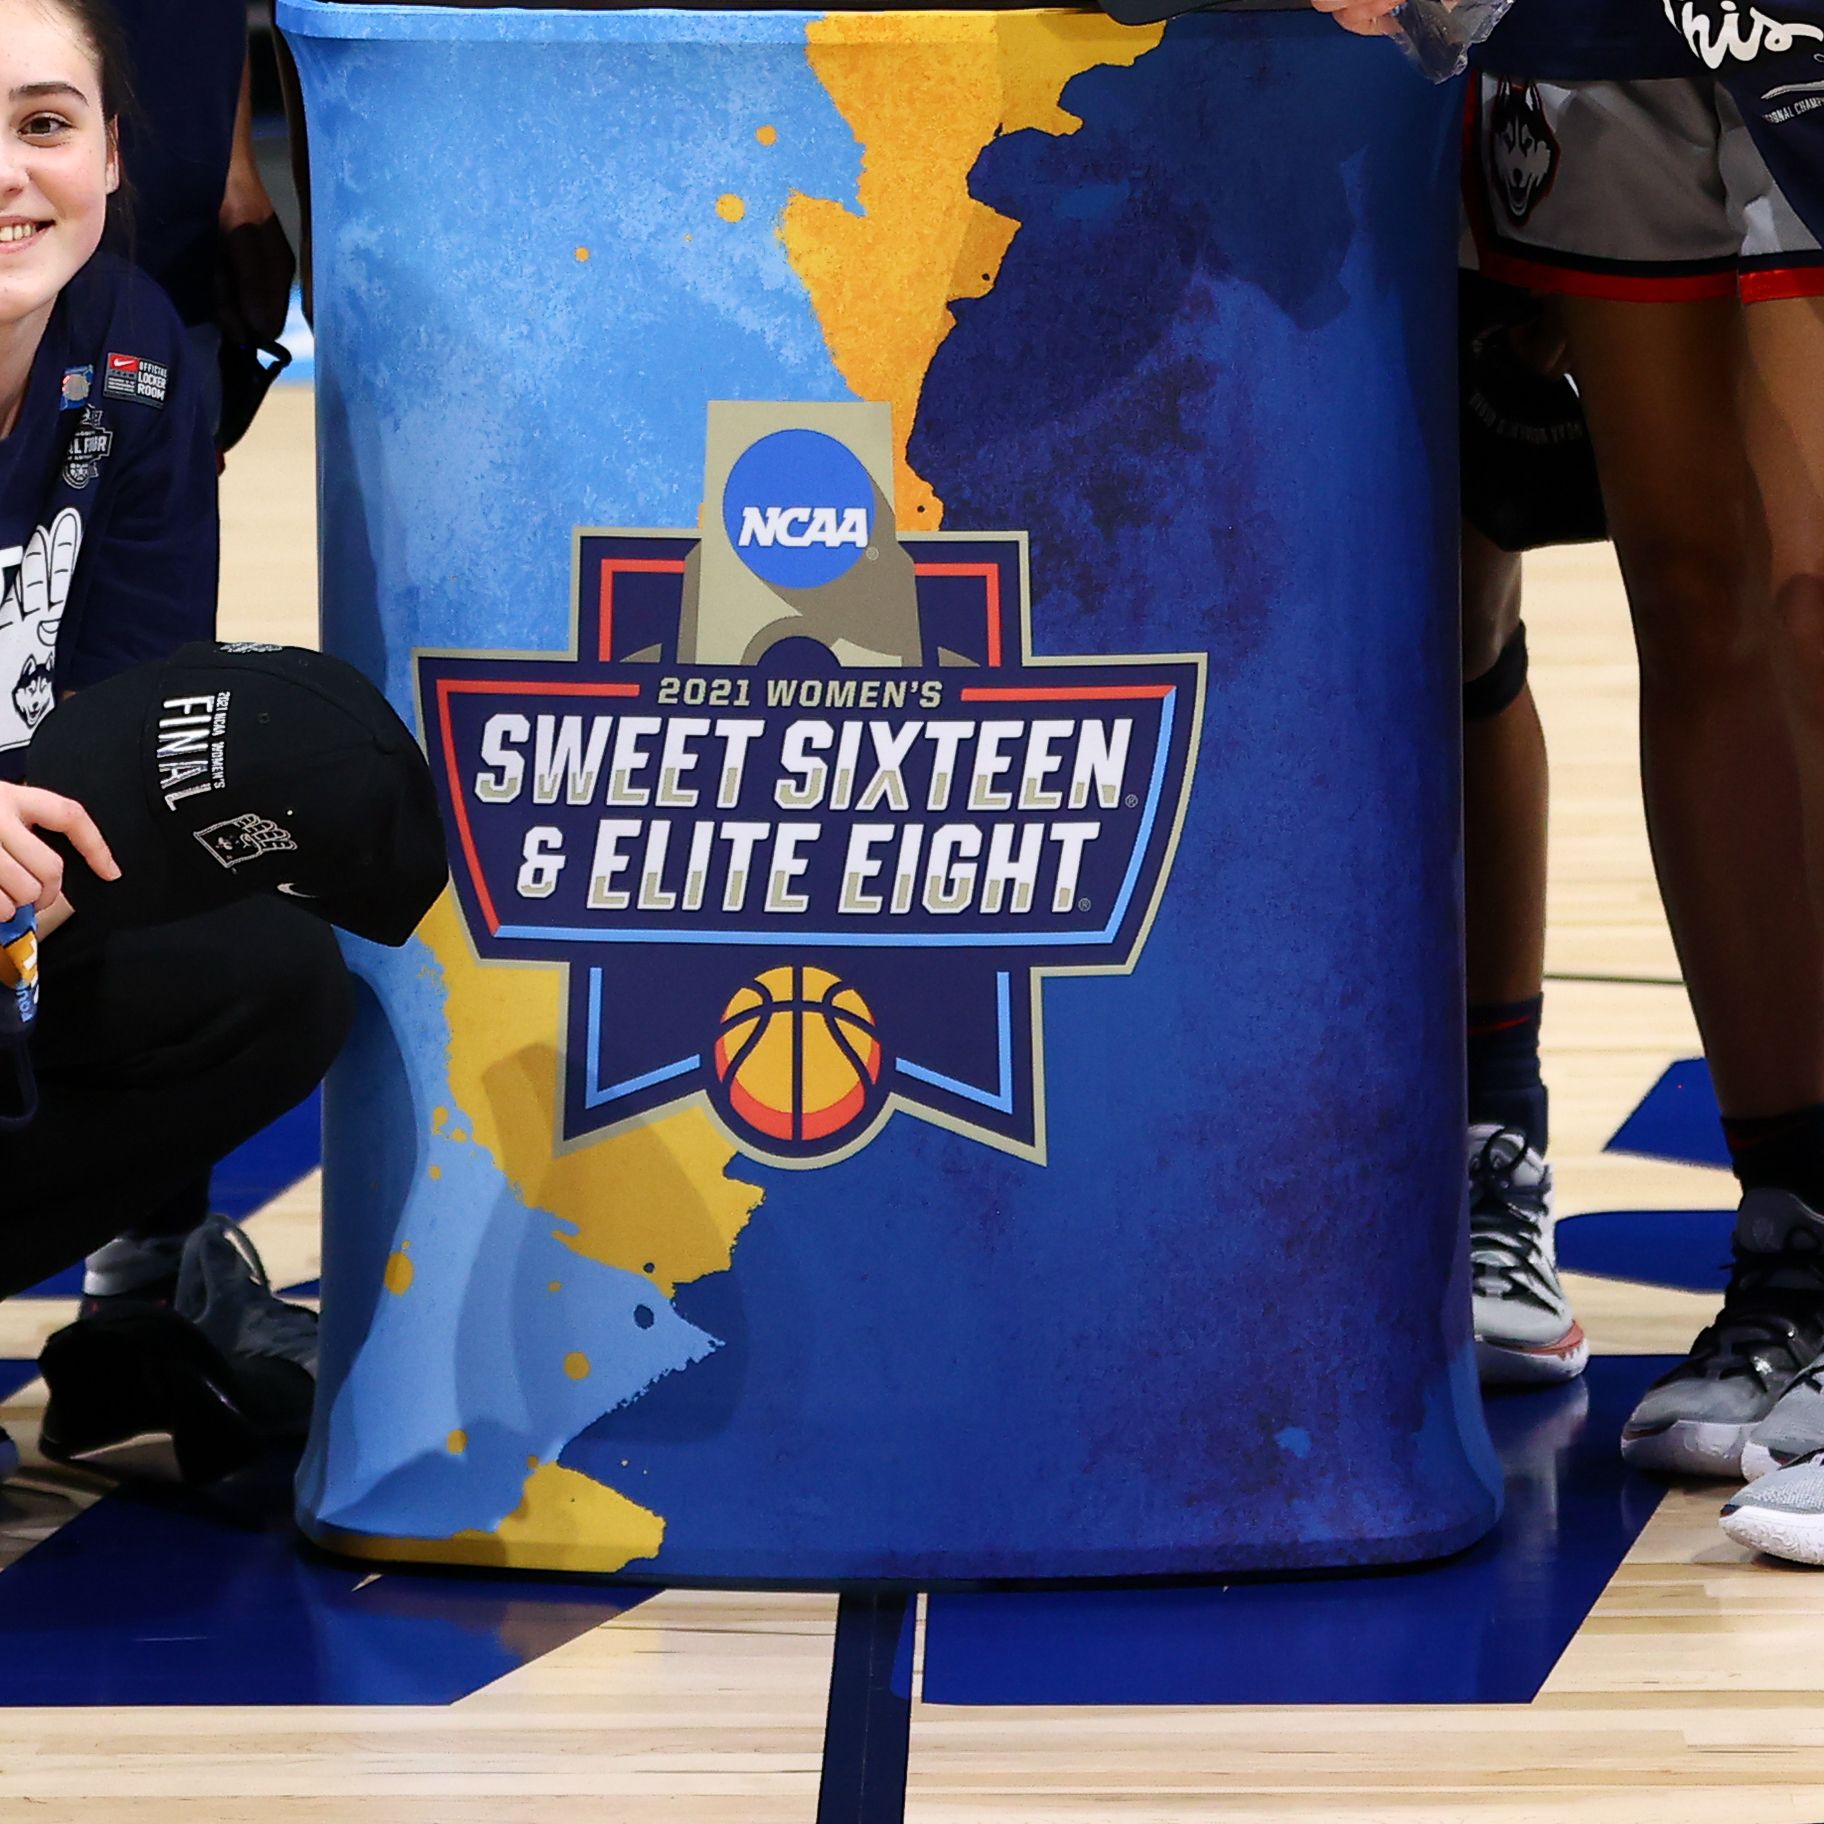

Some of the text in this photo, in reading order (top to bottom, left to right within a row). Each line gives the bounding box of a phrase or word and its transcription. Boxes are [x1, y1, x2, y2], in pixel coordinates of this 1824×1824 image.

[137, 372, 167, 389] LOCKER
[139, 361, 168, 377] OFFICIAL
[137, 383, 165, 401] ROOM
[738, 506, 868, 548] NCAA
[658, 677, 943, 709] 2021 WOMEN'S
[156, 694, 215, 812] FINAL
[211, 691, 231, 789] 2021 NCAA WOMEN'S
[474, 713, 1133, 812] SWEET SIXTEEN
[517, 818, 1101, 915] & ELITE EIGHT
